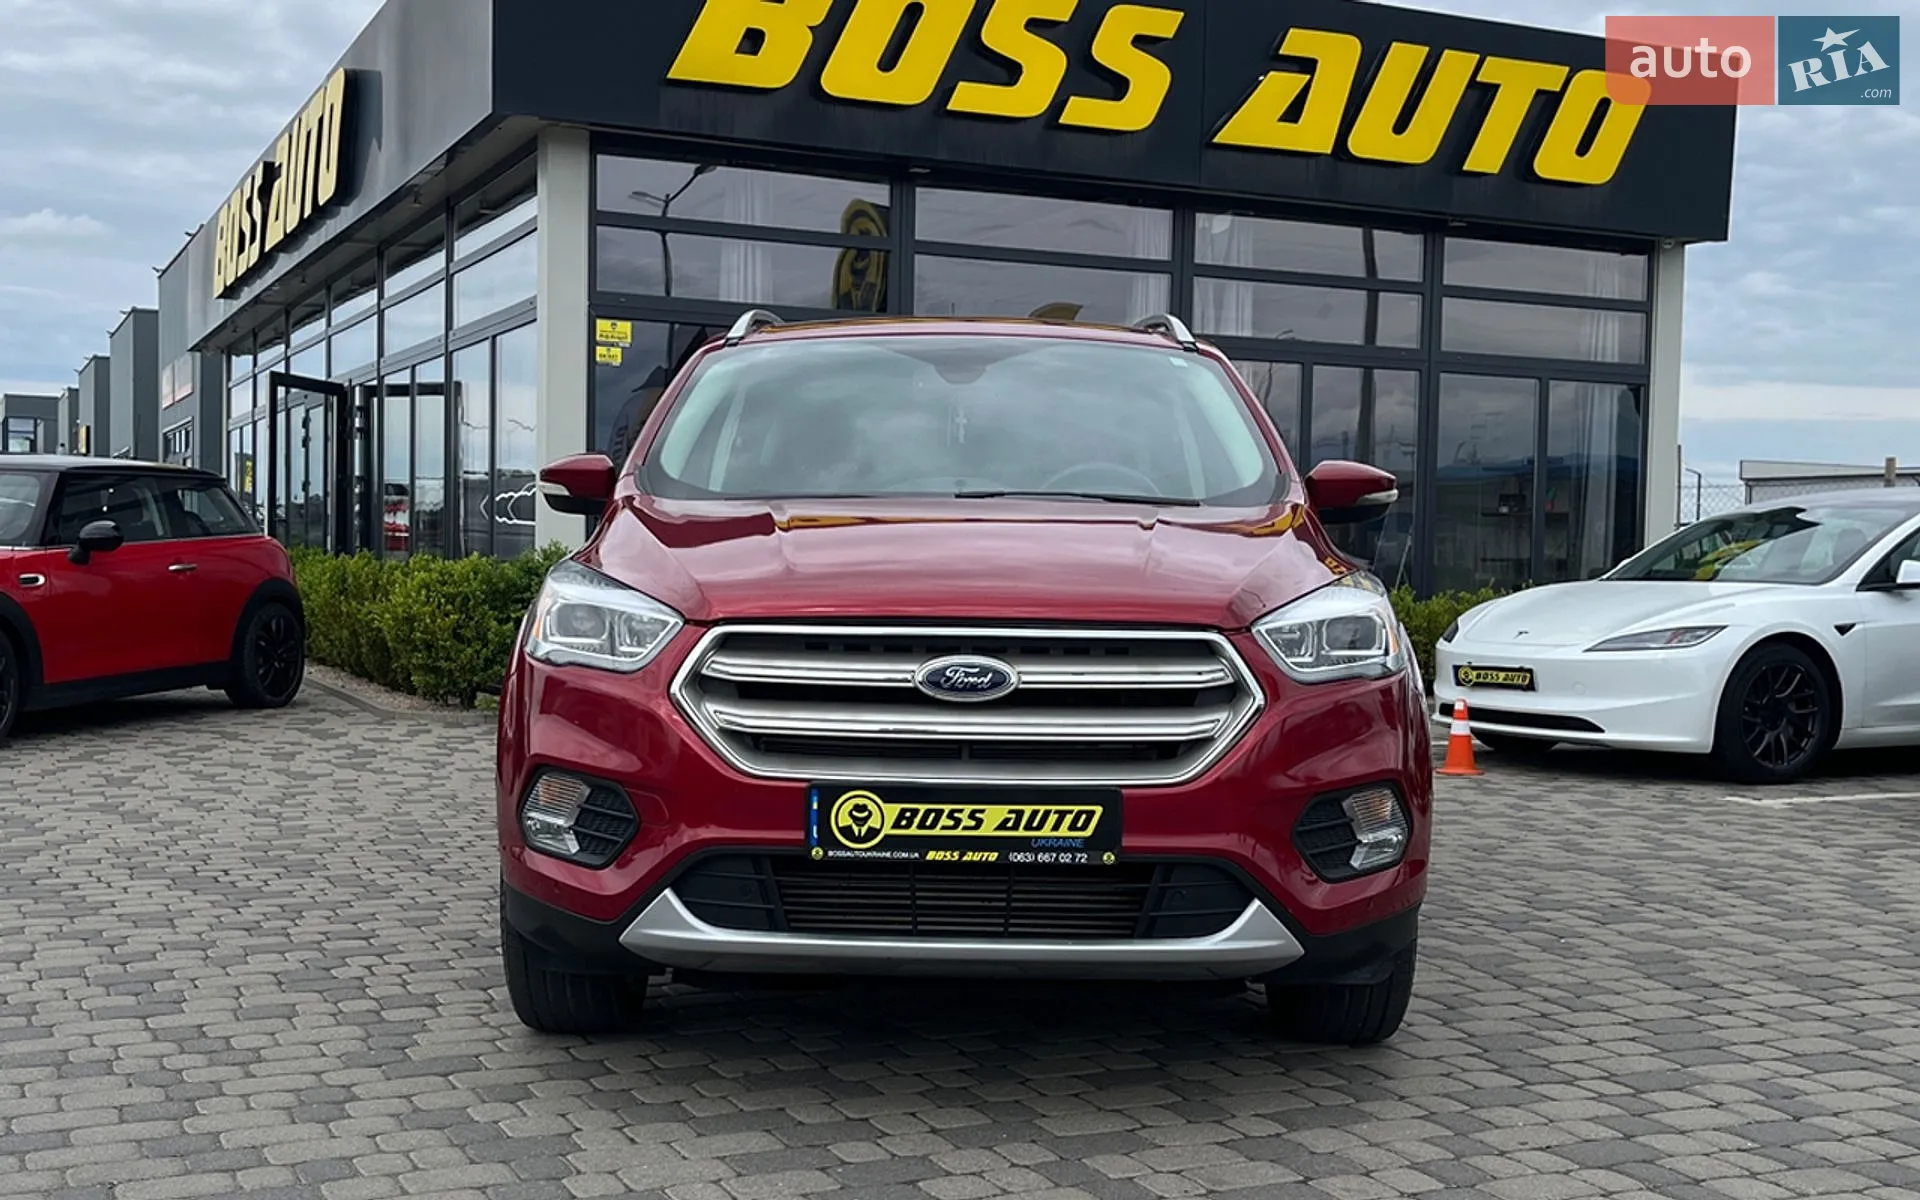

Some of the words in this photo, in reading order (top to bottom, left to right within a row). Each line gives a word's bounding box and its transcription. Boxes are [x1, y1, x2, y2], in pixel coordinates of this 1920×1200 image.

[668, 0, 1185, 132] BOSS
[1213, 27, 1651, 185] AUTO
[213, 160, 265, 299] BOSS
[264, 67, 346, 252] AUTO
[941, 665, 993, 689] Ford
[1475, 672, 1500, 681] BOSS
[891, 807, 986, 831] BOSS
[992, 808, 1097, 832] AUTO
[1031, 838, 1085, 848] UKRAINE
[925, 850, 960, 861] BOSS
[962, 852, 998, 861] AUTO
[1058, 853, 1072, 863] 02
[1074, 853, 1088, 863] 72
